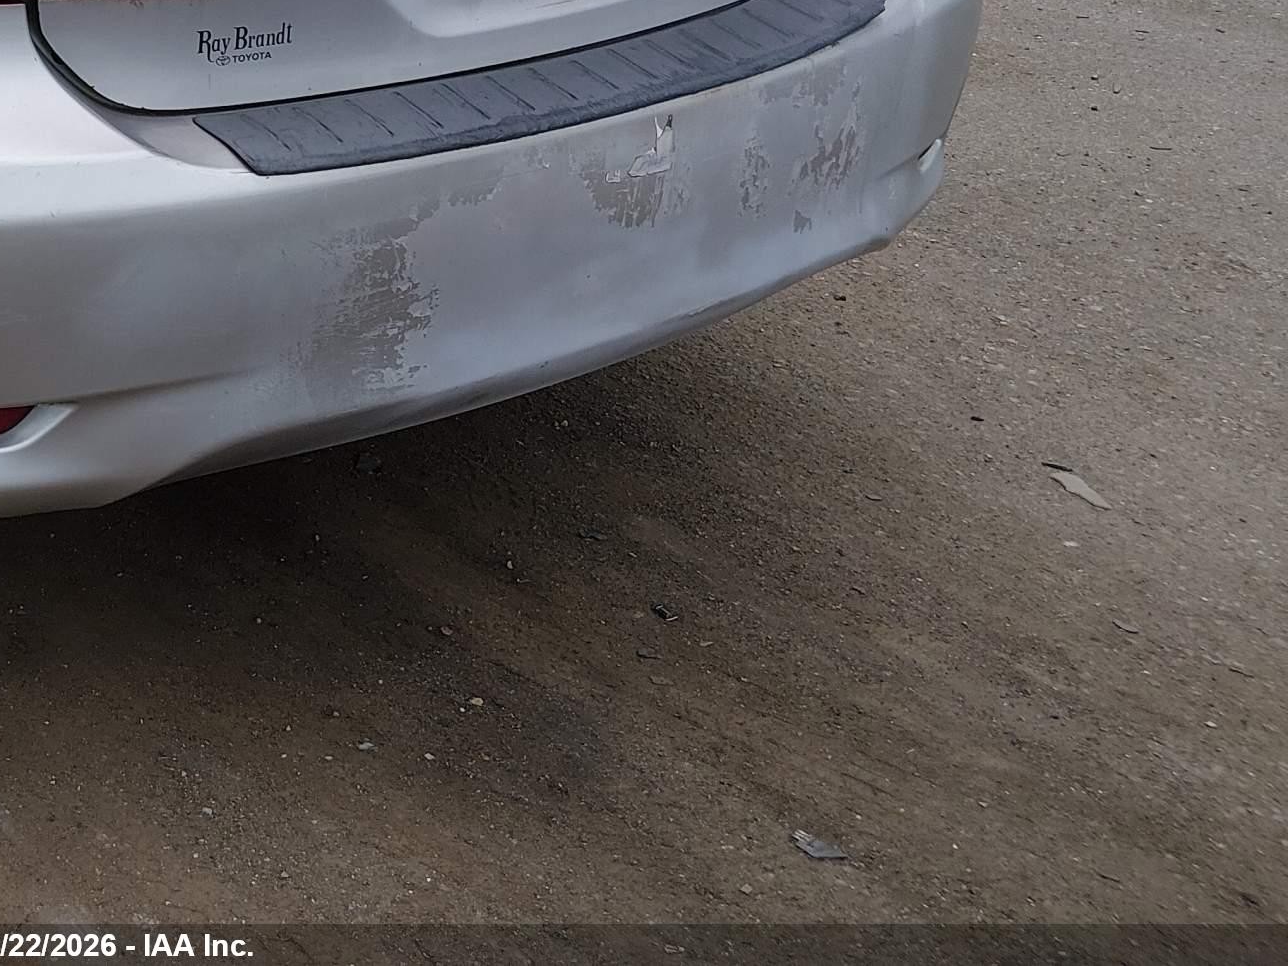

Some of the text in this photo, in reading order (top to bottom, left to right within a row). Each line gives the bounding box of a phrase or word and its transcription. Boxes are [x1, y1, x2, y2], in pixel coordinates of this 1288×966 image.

[196, 22, 293, 63] Ray Brandt
[232, 51, 272, 63] TOYOTA
